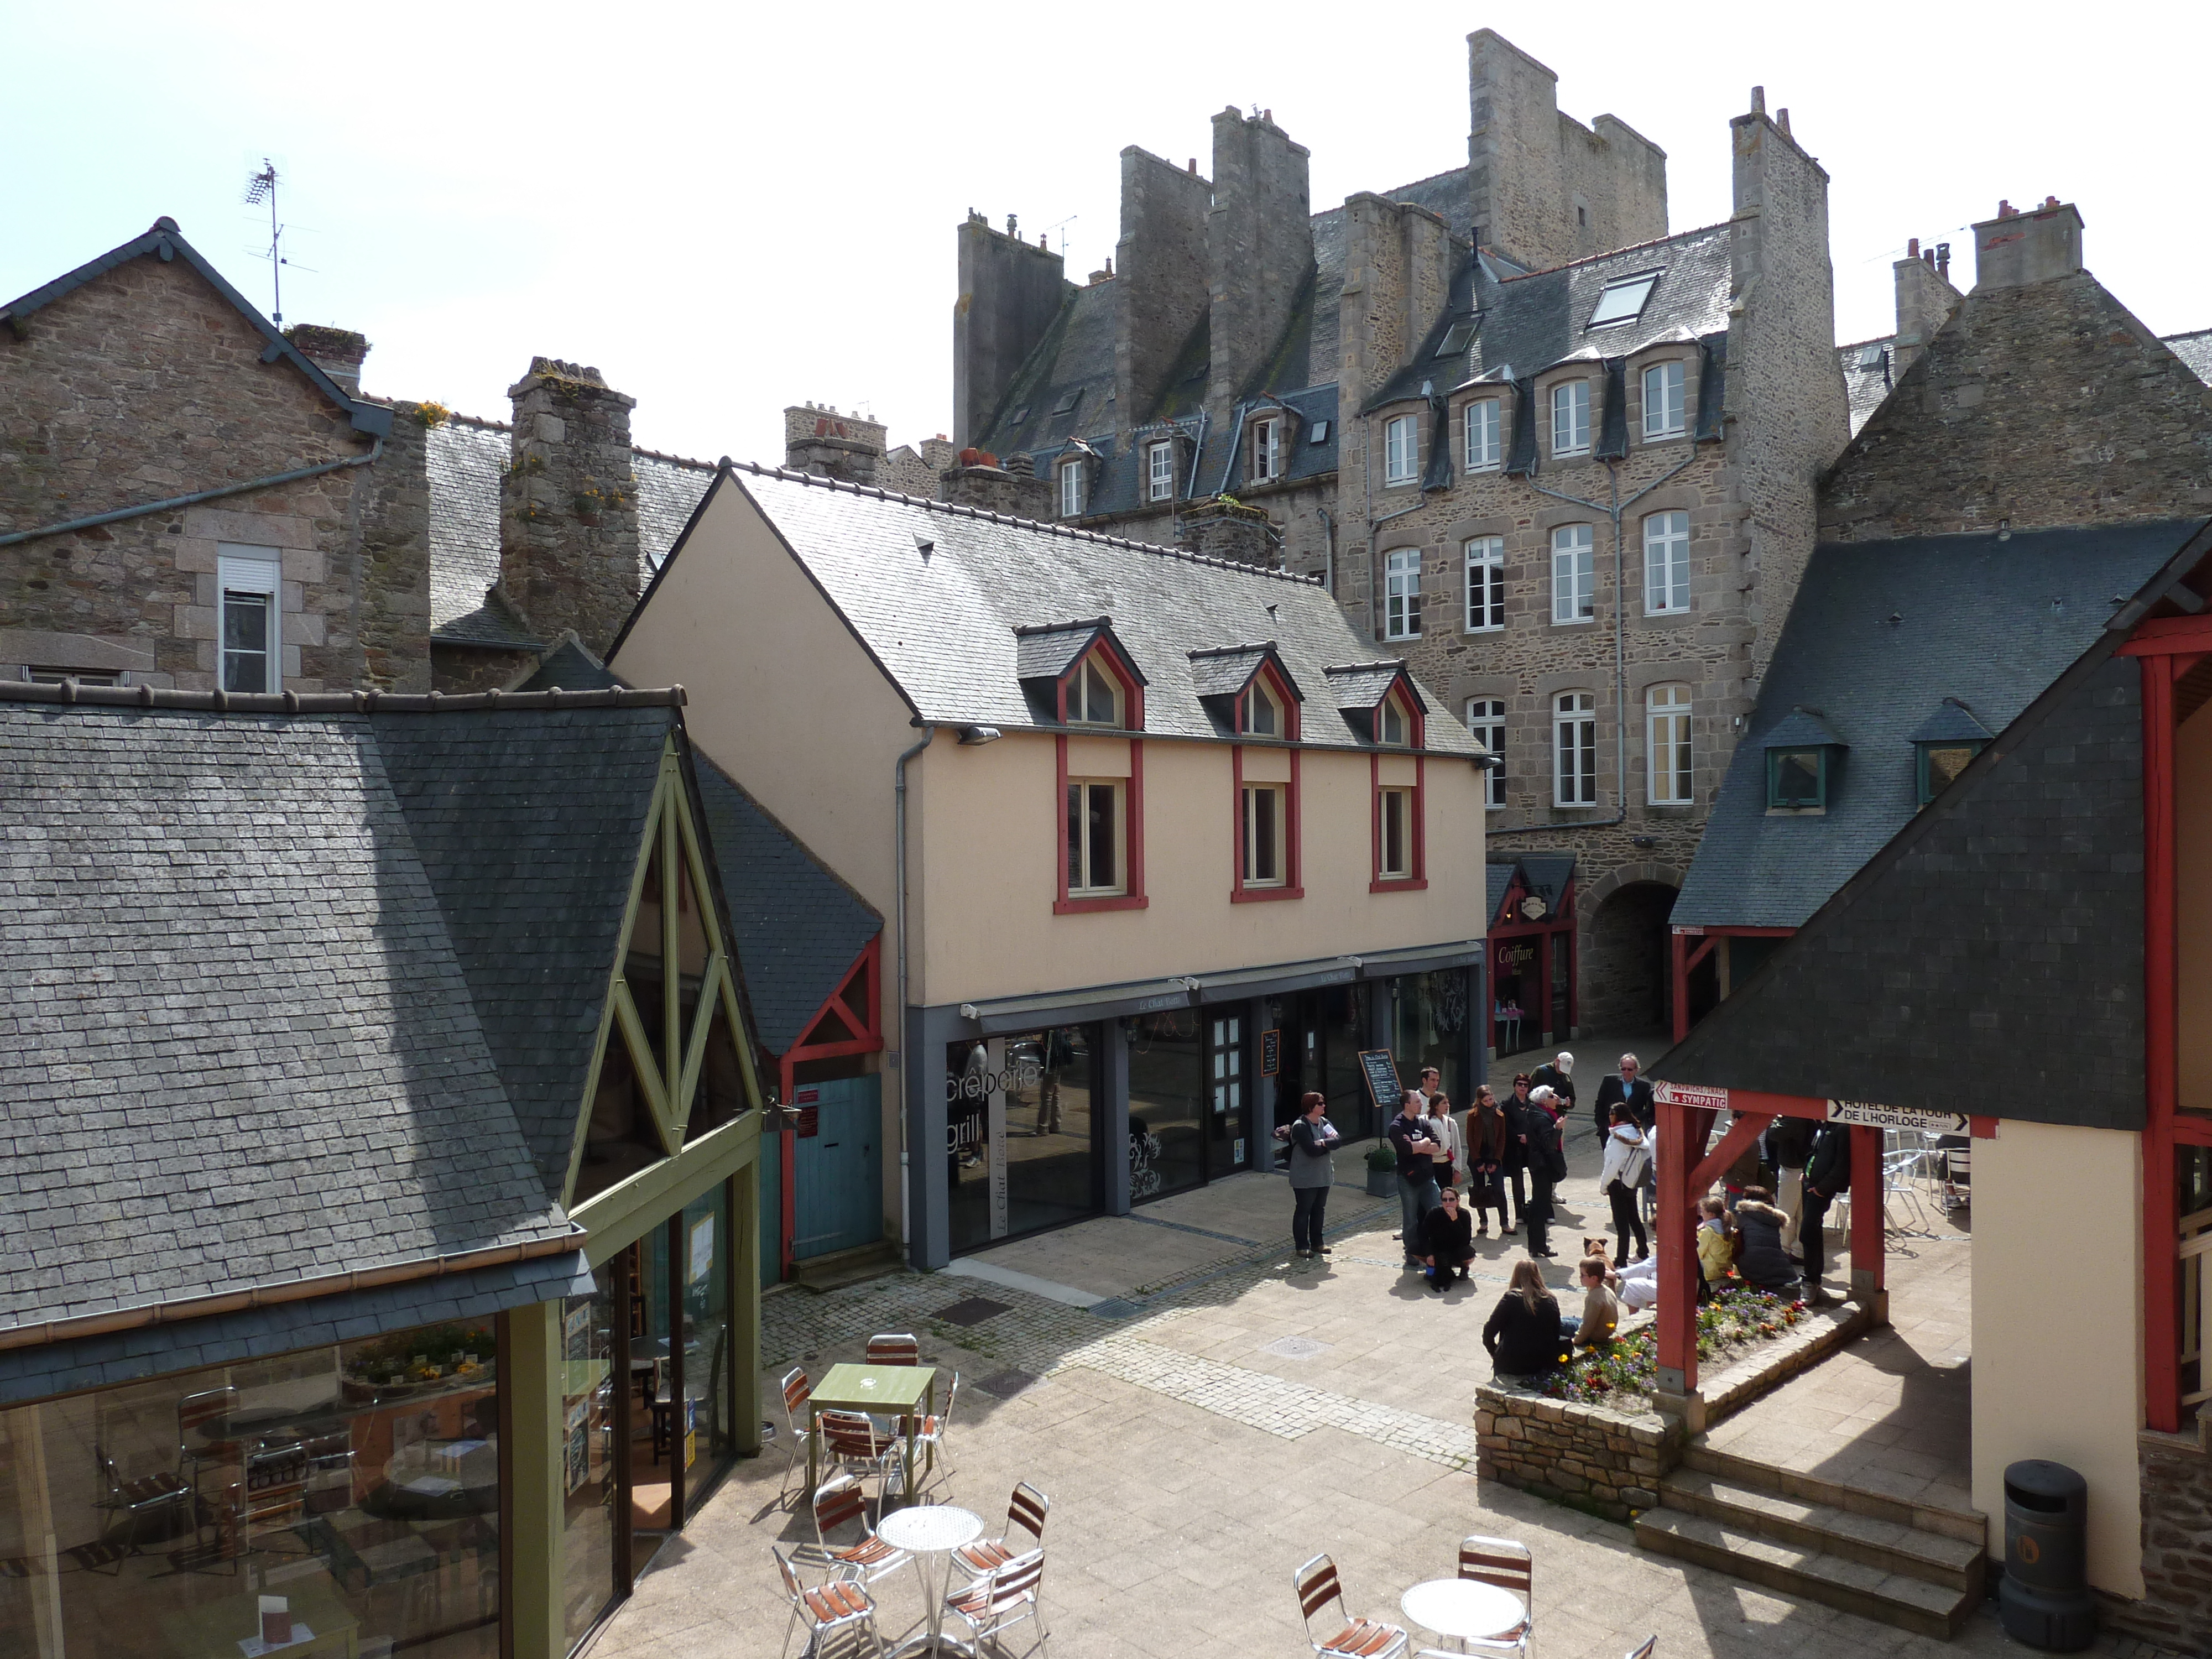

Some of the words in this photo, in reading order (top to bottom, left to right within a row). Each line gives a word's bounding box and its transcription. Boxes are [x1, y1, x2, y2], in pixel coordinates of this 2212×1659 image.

[1499, 945, 1533, 967] Coiffure
[947, 1063, 1037, 1102] crêperie
[1671, 1093, 1679, 1102] Le
[1682, 1095, 1725, 1108] SYMPATIC
[1902, 1107, 1917, 1115] LA
[1845, 1110, 1859, 1121] DE
[1863, 1112, 1927, 1128] L'HORLOGE
[947, 1113, 979, 1155] grill
[995, 1174, 1006, 1210] Chat
